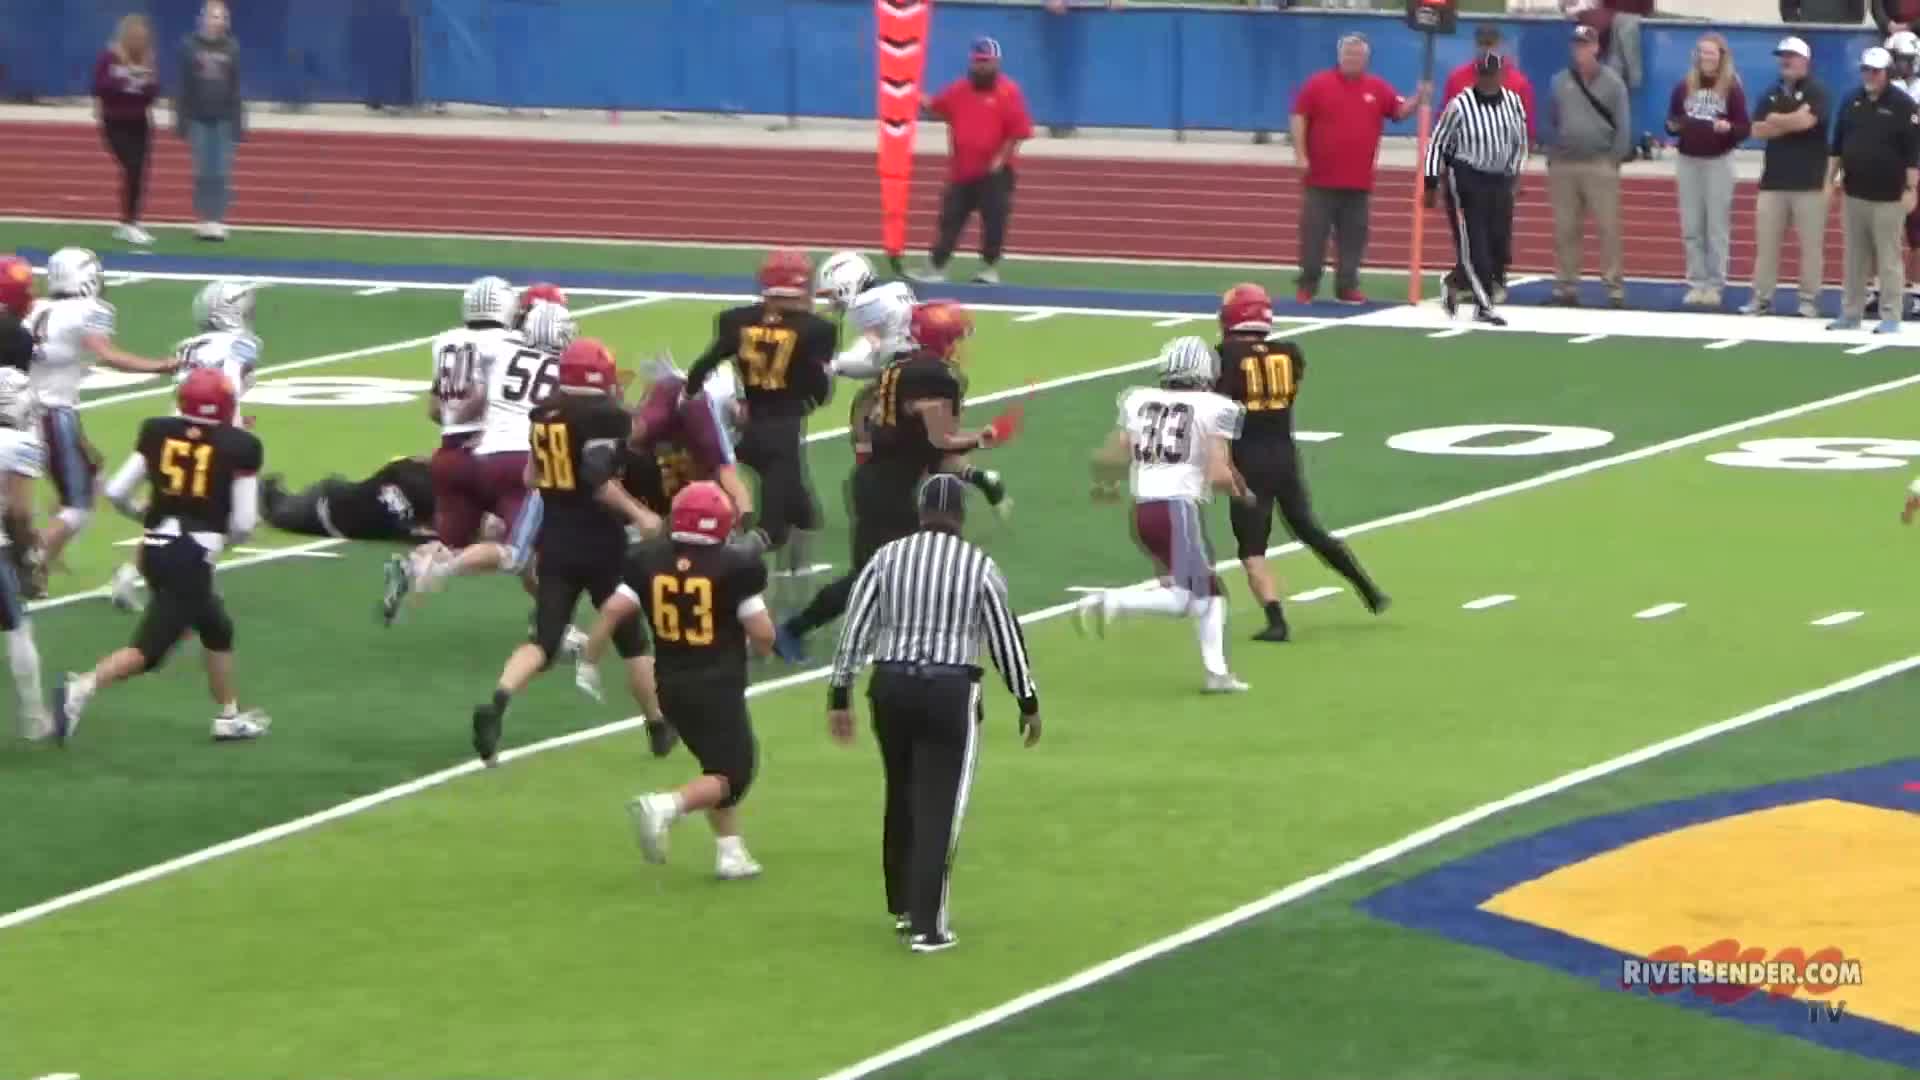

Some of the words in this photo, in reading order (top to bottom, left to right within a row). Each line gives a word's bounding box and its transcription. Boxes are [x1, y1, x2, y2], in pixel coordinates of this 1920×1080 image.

[503, 350, 561, 405] 56
[739, 325, 797, 390] 57
[1240, 354, 1297, 411] 10
[530, 422, 576, 489] 58
[1135, 401, 1195, 464] 33
[160, 438, 213, 497] 51
[652, 574, 714, 646] 63
